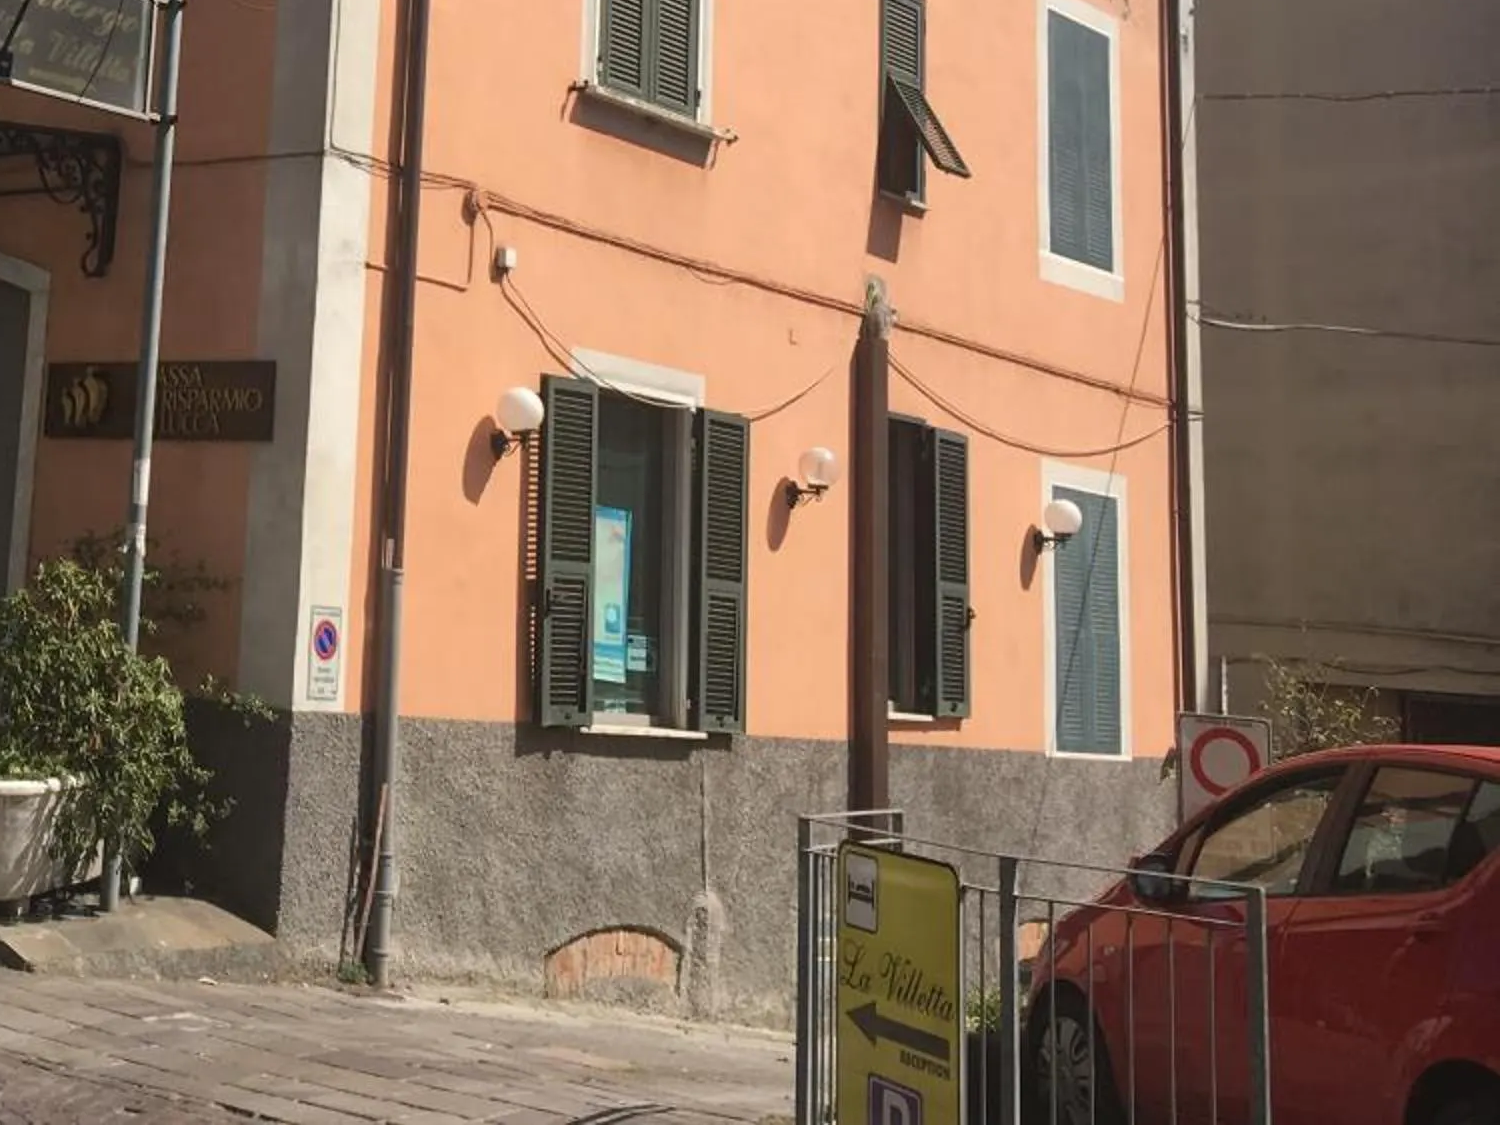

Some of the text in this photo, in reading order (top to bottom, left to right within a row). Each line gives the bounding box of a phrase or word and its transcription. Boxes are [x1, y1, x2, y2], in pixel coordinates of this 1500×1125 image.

[160, 364, 204, 387] ASSA
[162, 387, 263, 414] RISPARMIO
[840, 937, 954, 1022] La Villetta
